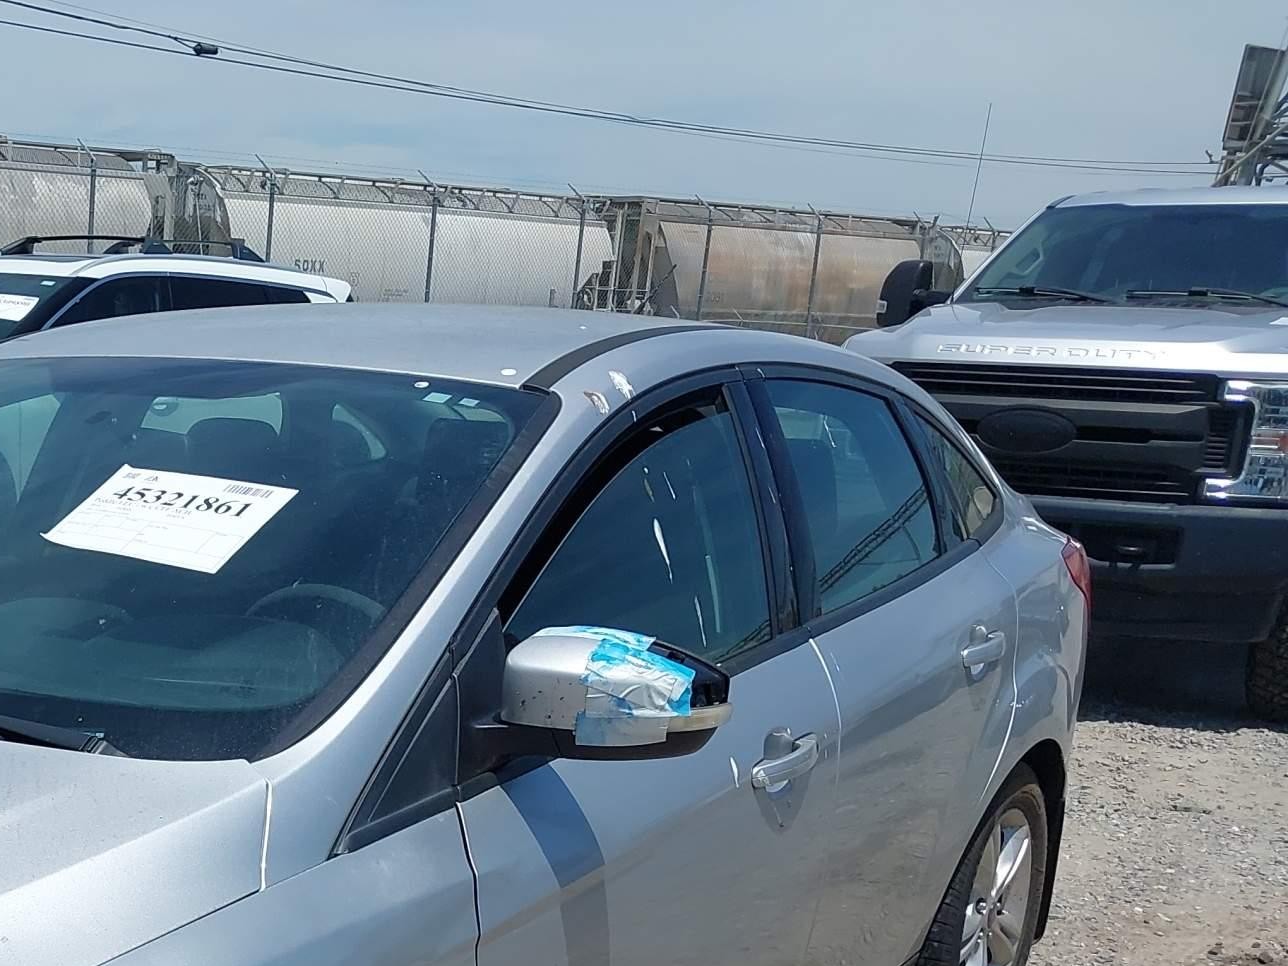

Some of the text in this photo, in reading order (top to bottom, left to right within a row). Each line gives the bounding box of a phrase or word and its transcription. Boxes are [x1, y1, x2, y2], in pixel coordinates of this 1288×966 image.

[294, 259, 327, 273] SOXX
[936, 343, 1166, 360] SUPER DUTY
[113, 485, 254, 517] 45321861
